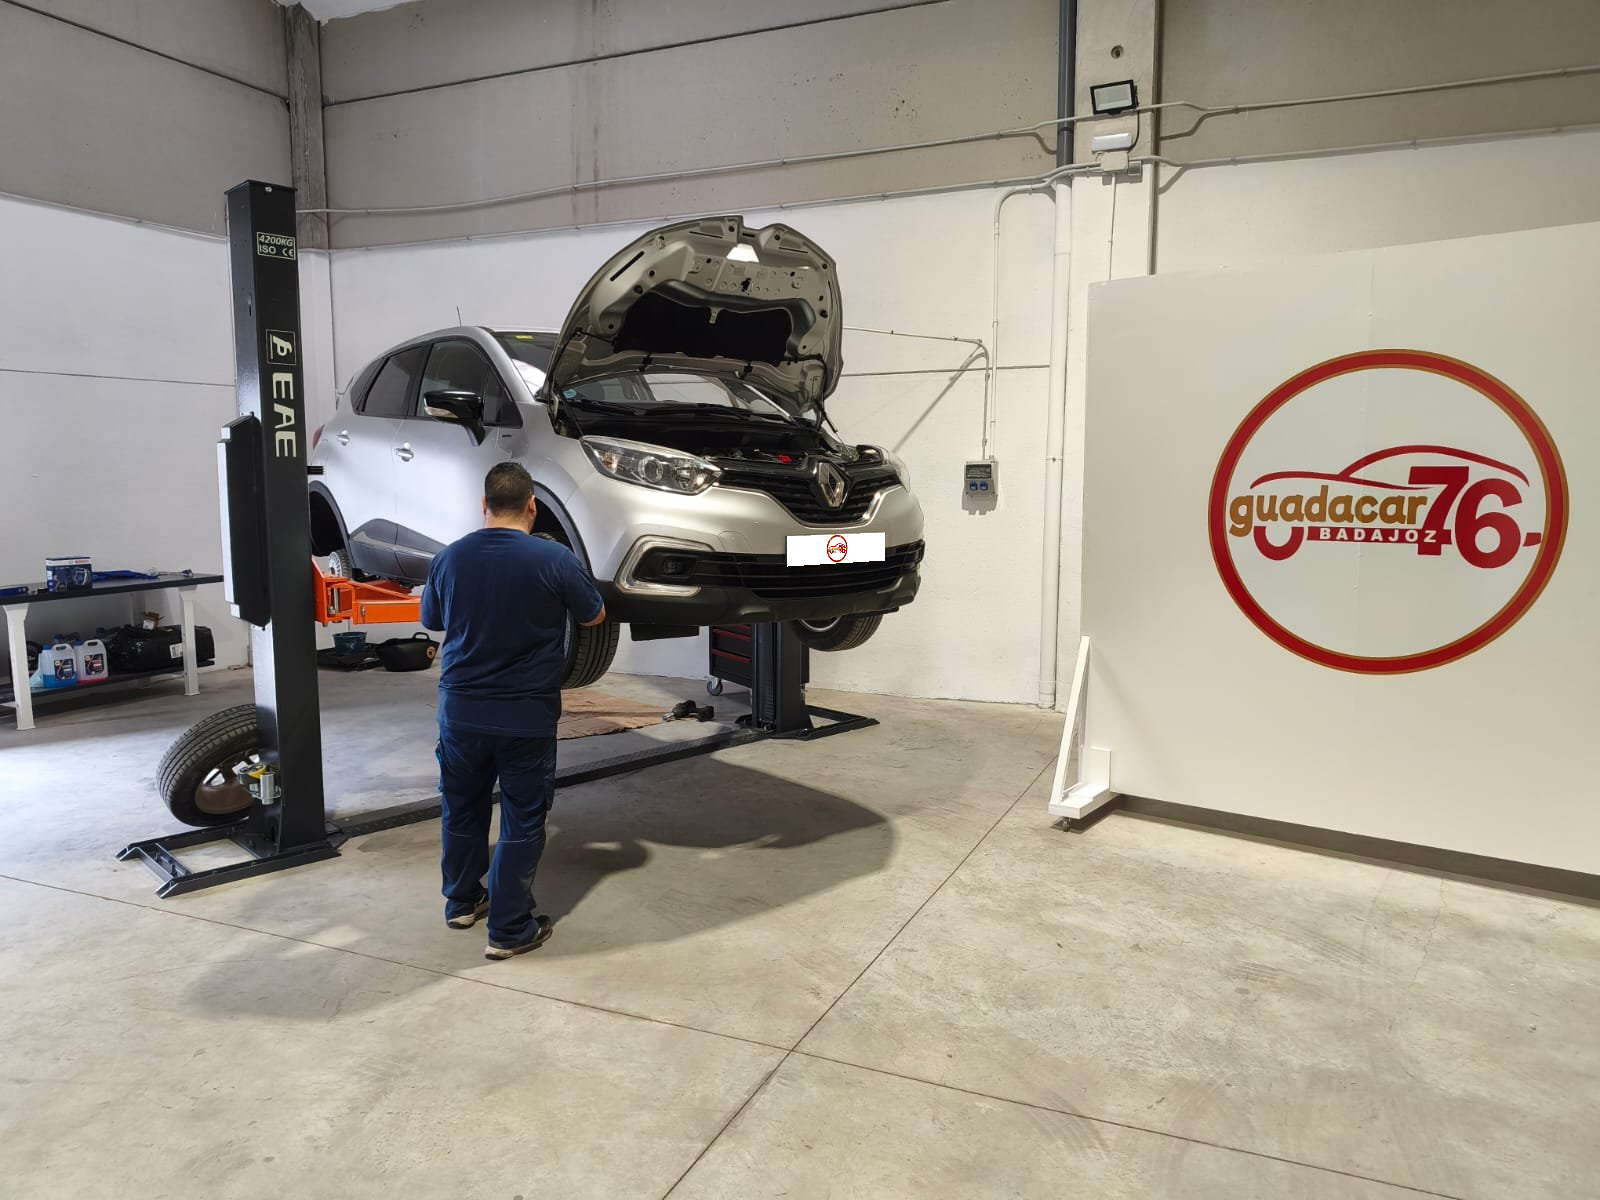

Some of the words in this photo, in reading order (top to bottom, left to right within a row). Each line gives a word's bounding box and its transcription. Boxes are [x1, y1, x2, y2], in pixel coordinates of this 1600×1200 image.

[259, 234, 293, 247] 4200KG
[259, 244, 277, 255] ISO
[282, 247, 294, 257] CE
[272, 372, 297, 457] EAE
[1229, 484, 1428, 537] guadacar
[1319, 527, 1437, 543] BADAJOZ
